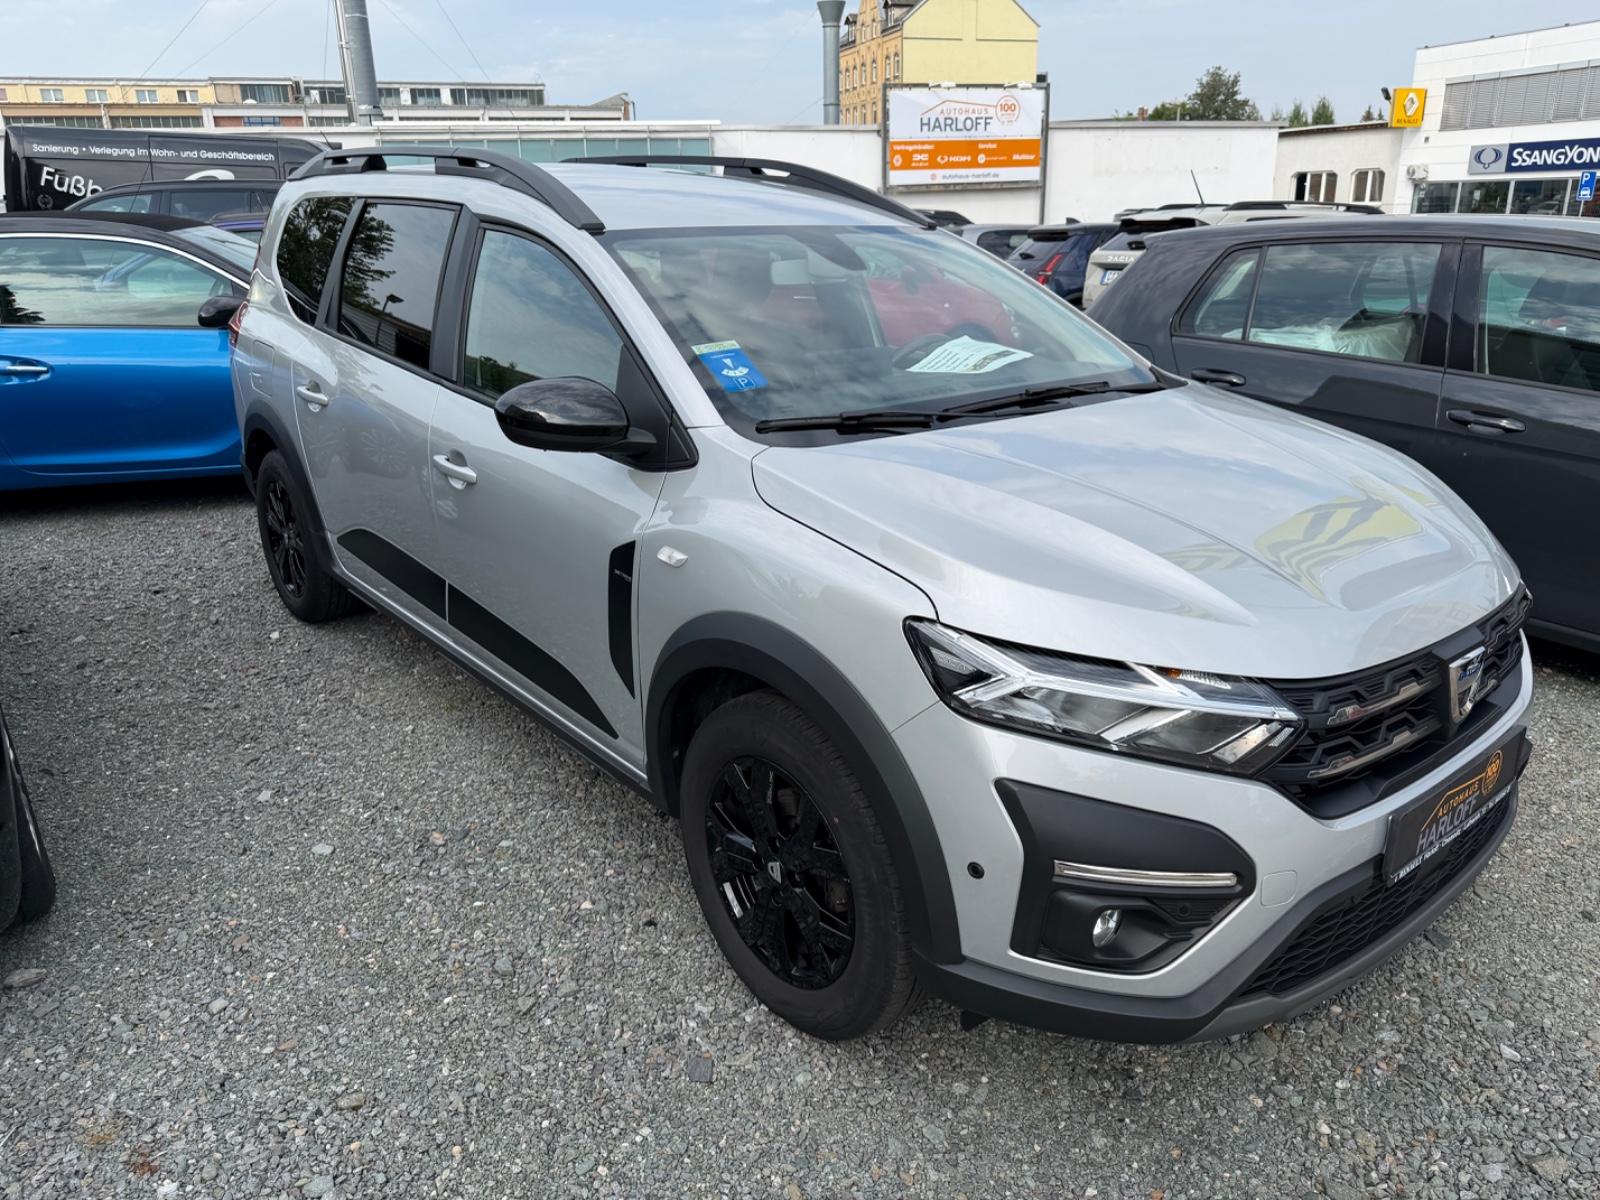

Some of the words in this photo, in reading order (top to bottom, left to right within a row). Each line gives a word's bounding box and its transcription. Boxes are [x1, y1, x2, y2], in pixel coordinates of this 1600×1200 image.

[940, 107, 989, 116] AUTOHAUS
[999, 103, 1016, 113] 100
[920, 116, 994, 133] HARLOFF
[32, 143, 79, 155] Sanierung
[89, 145, 136, 157] Verlegung
[137, 147, 149, 156] im
[149, 148, 179, 157] Wohn-
[180, 150, 198, 158] und
[199, 150, 276, 161] Geschäftsbereich
[1511, 145, 1600, 167] SSANGYON
[1582, 173, 1590, 184] P
[1438, 780, 1479, 818] AUTOHAUS
[1416, 789, 1480, 856] HARLOFF
